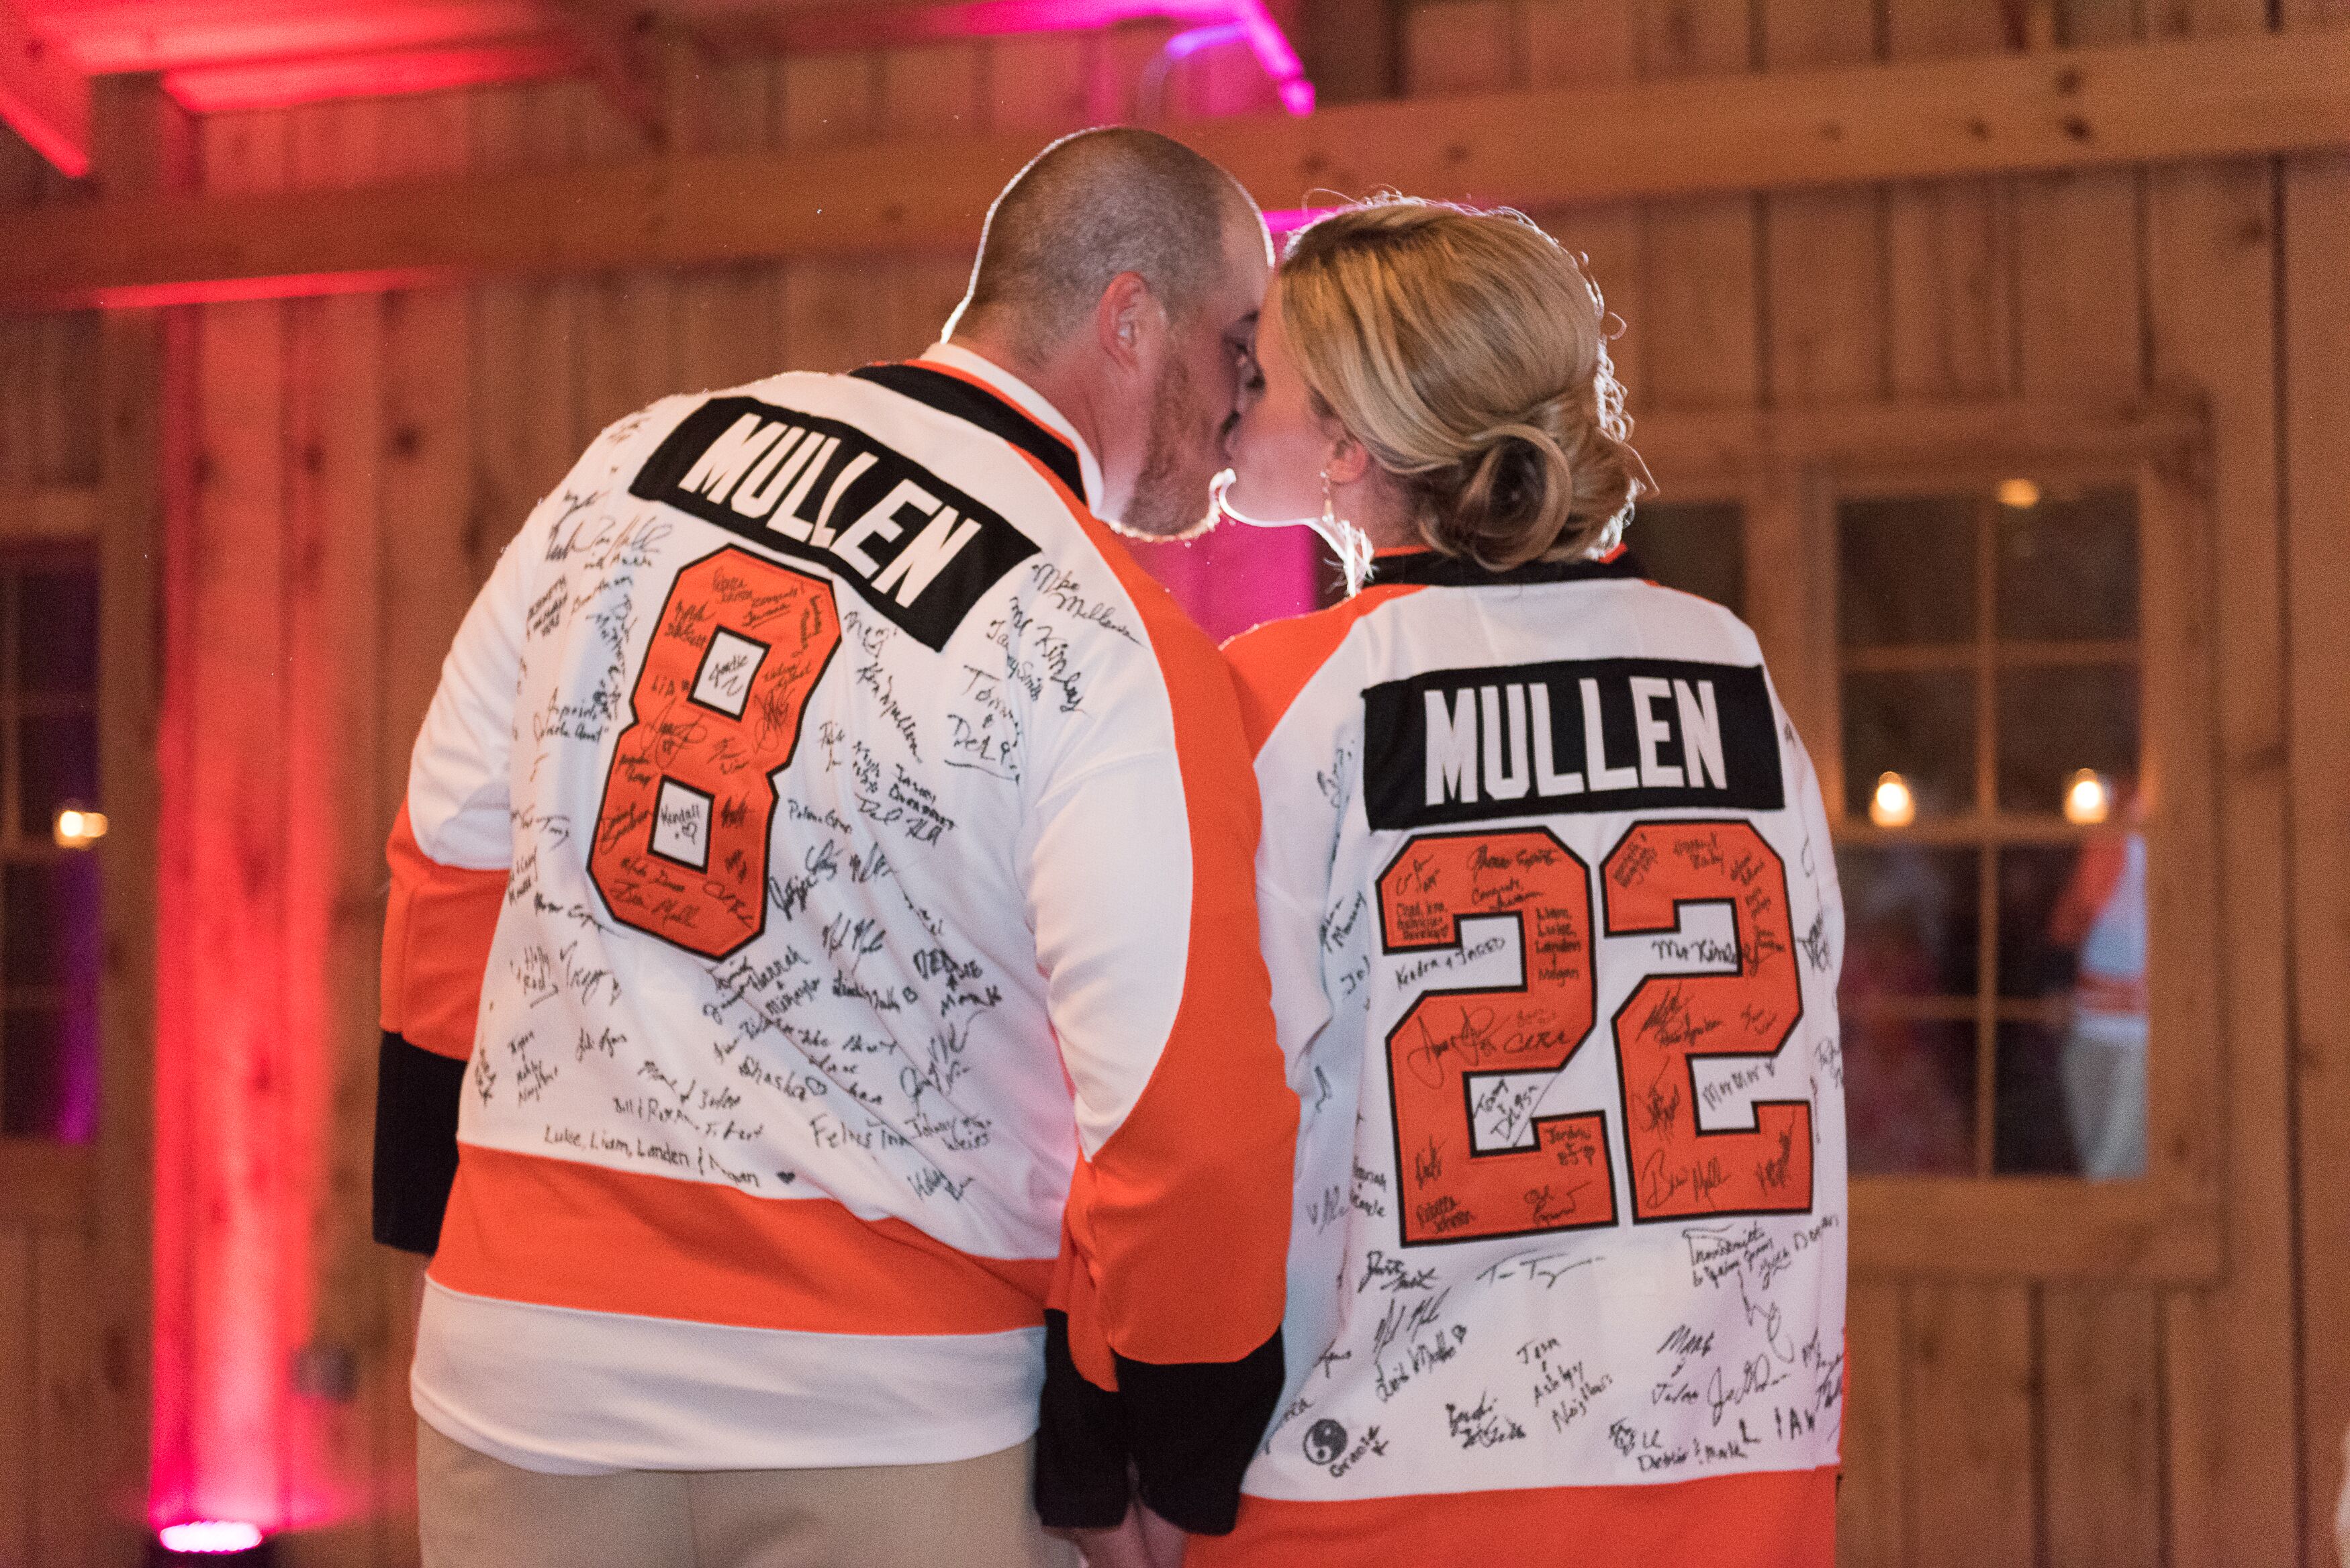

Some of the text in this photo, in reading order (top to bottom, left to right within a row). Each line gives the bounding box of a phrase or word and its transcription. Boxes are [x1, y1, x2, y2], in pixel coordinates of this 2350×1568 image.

[678, 412, 982, 609] MULLEN
[586, 542, 842, 964] 8
[1423, 675, 1728, 806] MULLEN
[1374, 820, 1814, 1248] 22
